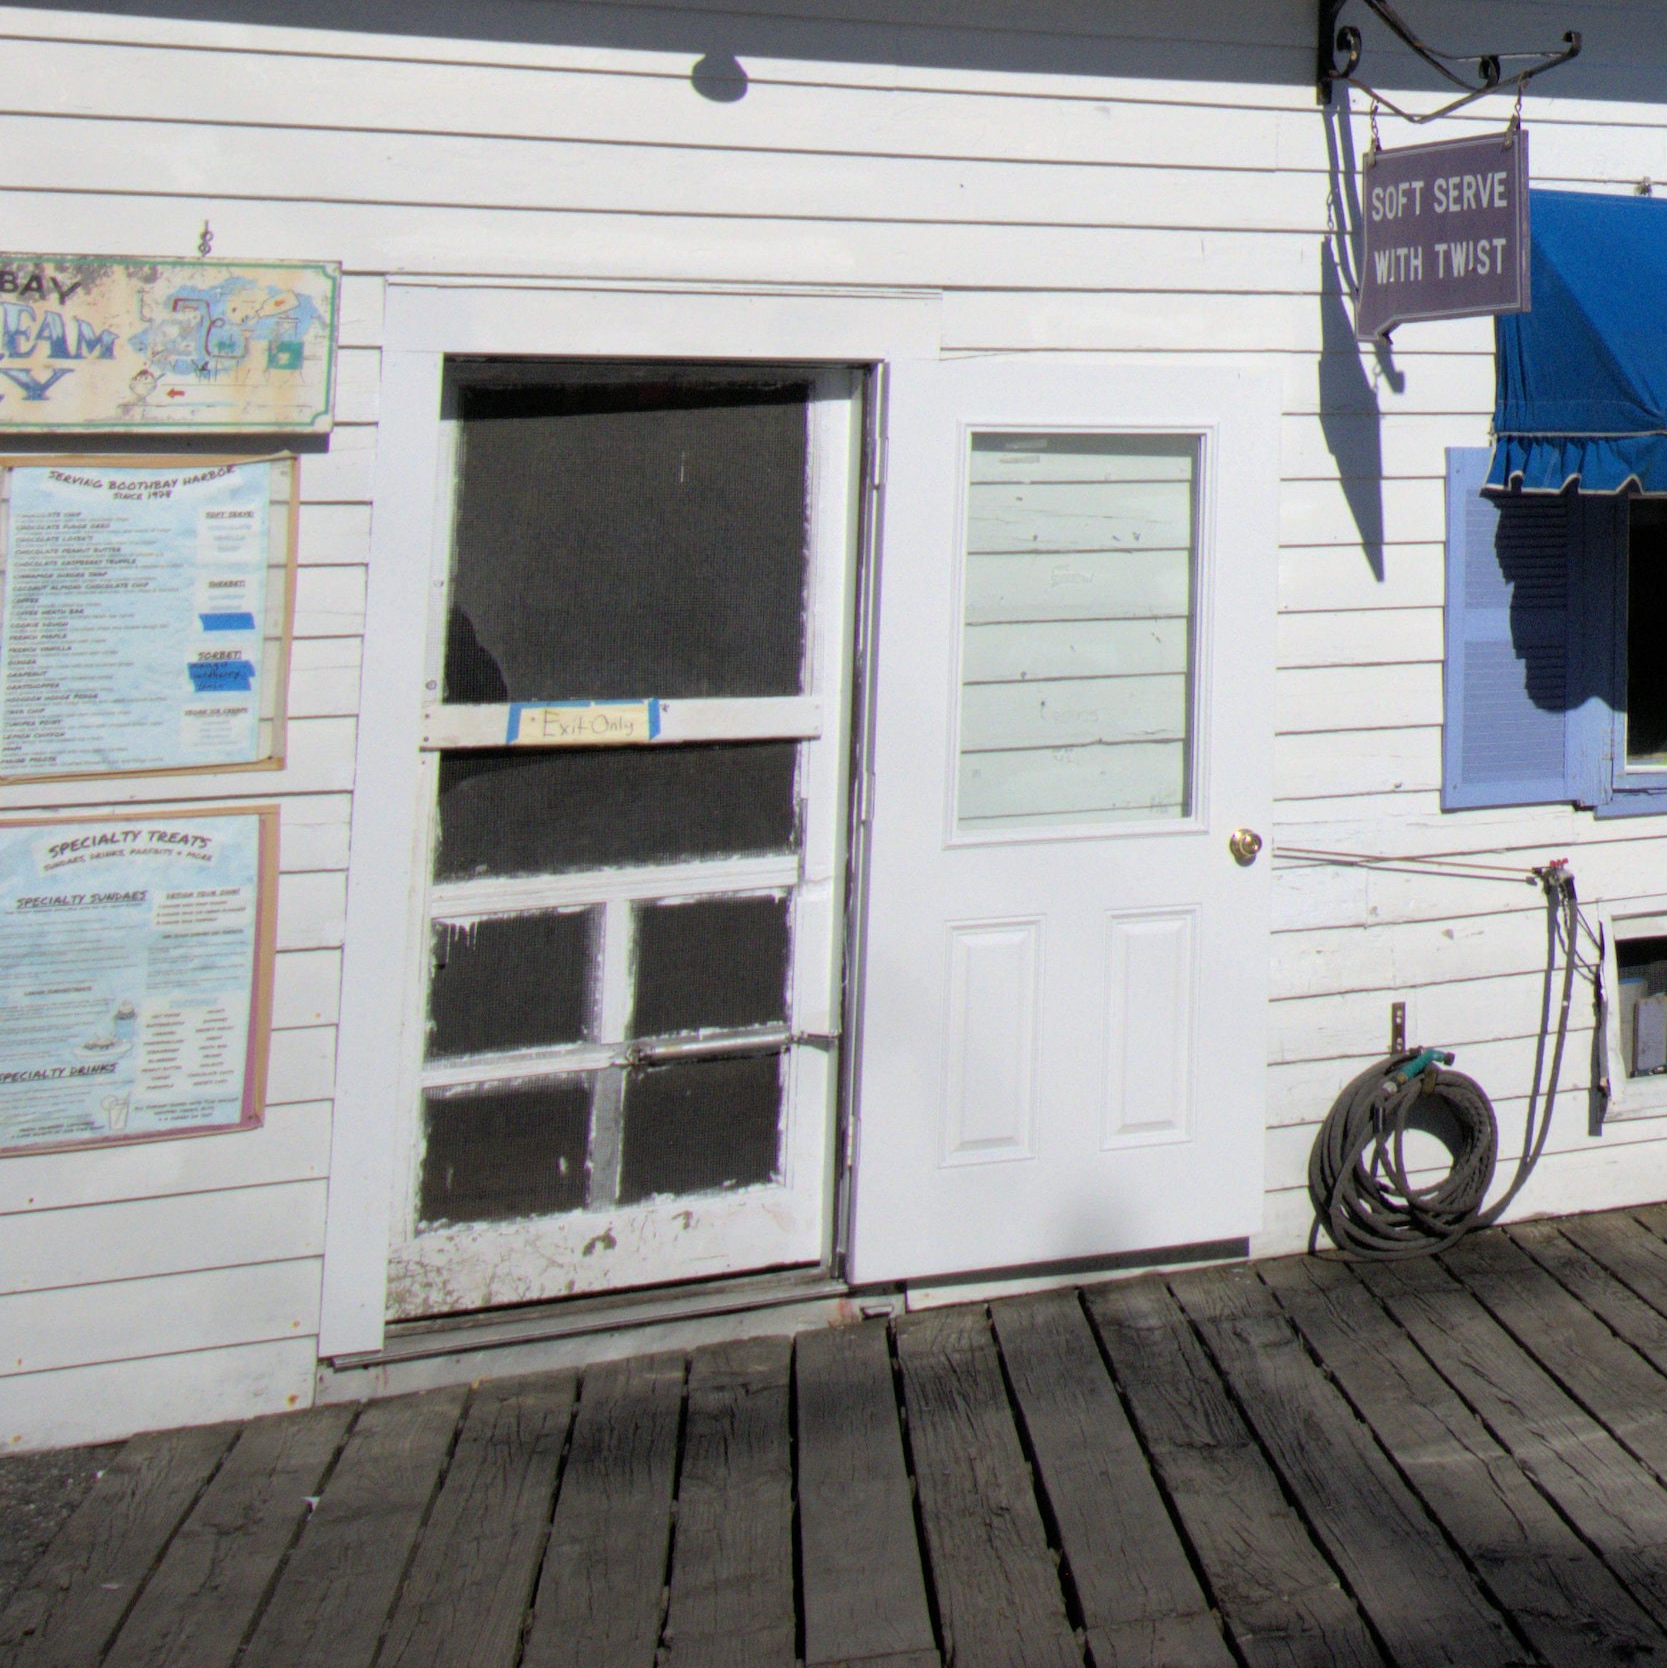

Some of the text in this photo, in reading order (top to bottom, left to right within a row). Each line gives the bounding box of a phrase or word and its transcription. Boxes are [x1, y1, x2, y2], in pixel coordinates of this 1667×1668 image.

[1372, 172, 1507, 221] SOFT SERVE
[1374, 238, 1506, 284] WITH TWIST
[0, 301, 120, 359] EAM
[0, 367, 75, 401] Y
[48, 466, 236, 490] SERVING BOOTHBAY HARBOR
[112, 490, 143, 500] SINCE
[542, 709, 635, 737] Exit Only
[48, 830, 212, 859] SPECIALTY TREATS
[16, 894, 86, 909] SPECIALTY
[90, 890, 148, 904] SUNDAES
[70, 1062, 119, 1077] DRINKS
